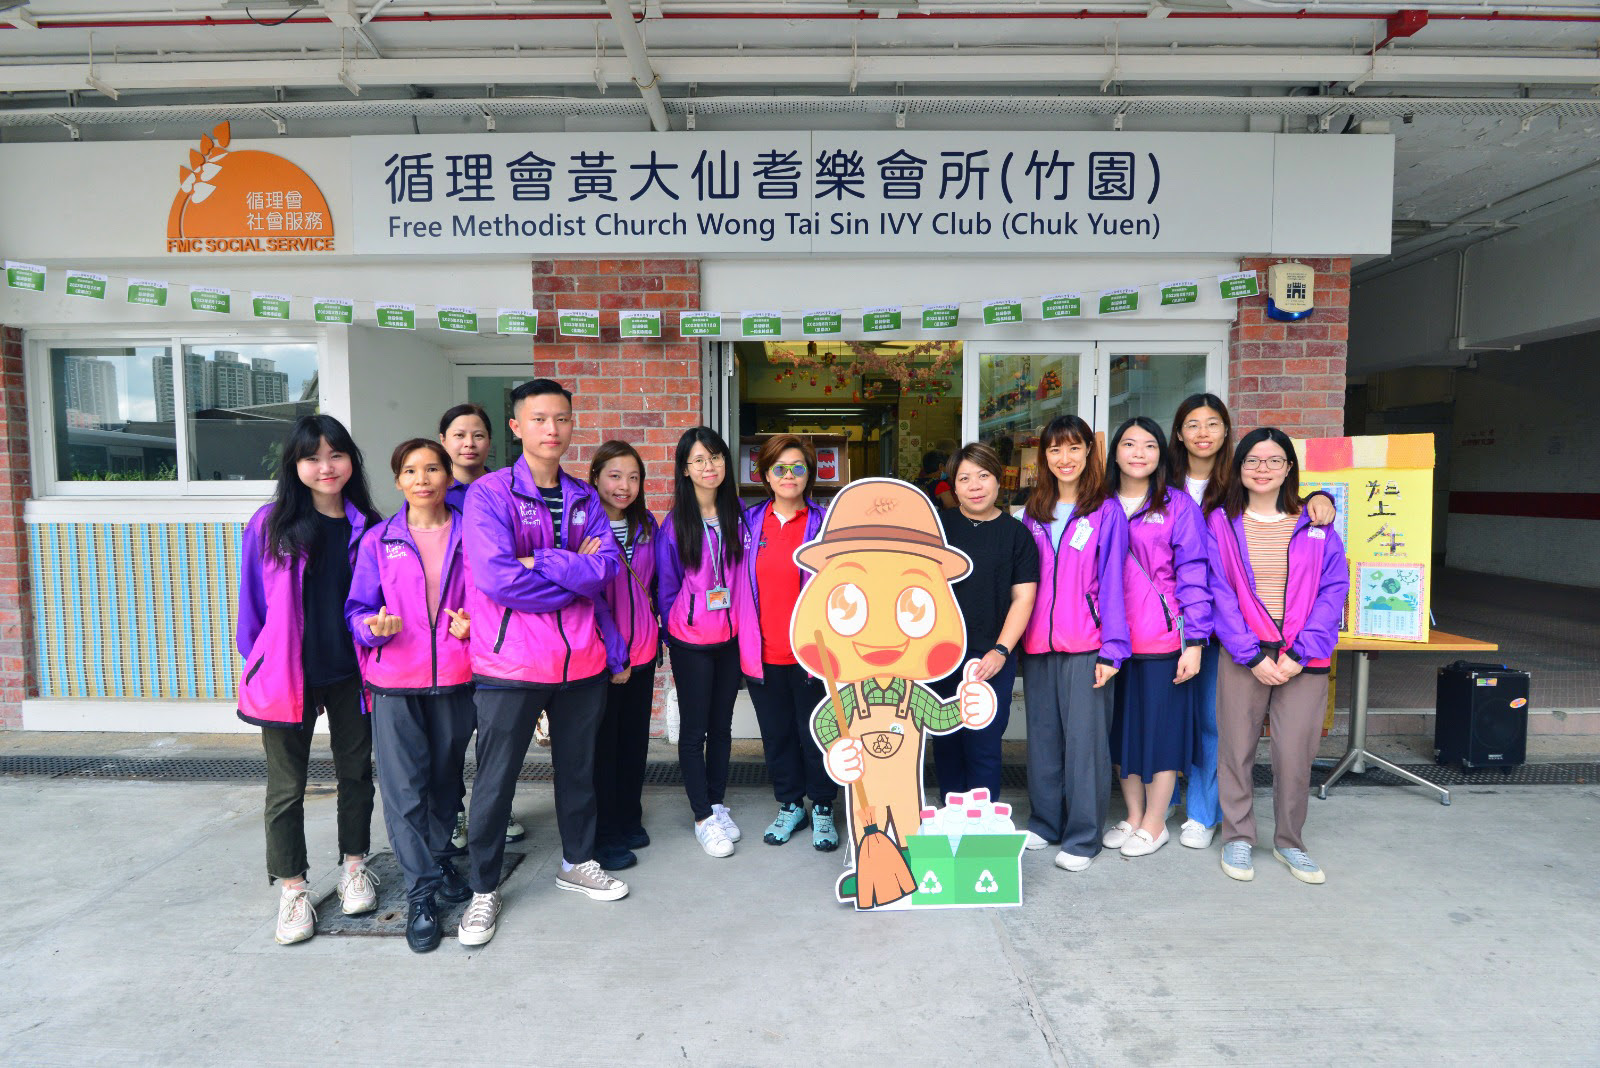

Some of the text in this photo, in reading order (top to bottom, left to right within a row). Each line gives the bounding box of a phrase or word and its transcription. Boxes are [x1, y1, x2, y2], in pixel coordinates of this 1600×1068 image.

[384, 149, 1161, 204] 循理會黃大仙耆樂會所(竹園)
[246, 190, 303, 210] 循理會
[246, 211, 323, 231] 社會服務
[389, 211, 1161, 242] Free Methodist Church Wong Tai Sin IVY Club (Chuk Yuen)
[166, 237, 335, 253] FMC SOCIAL SERVICE
